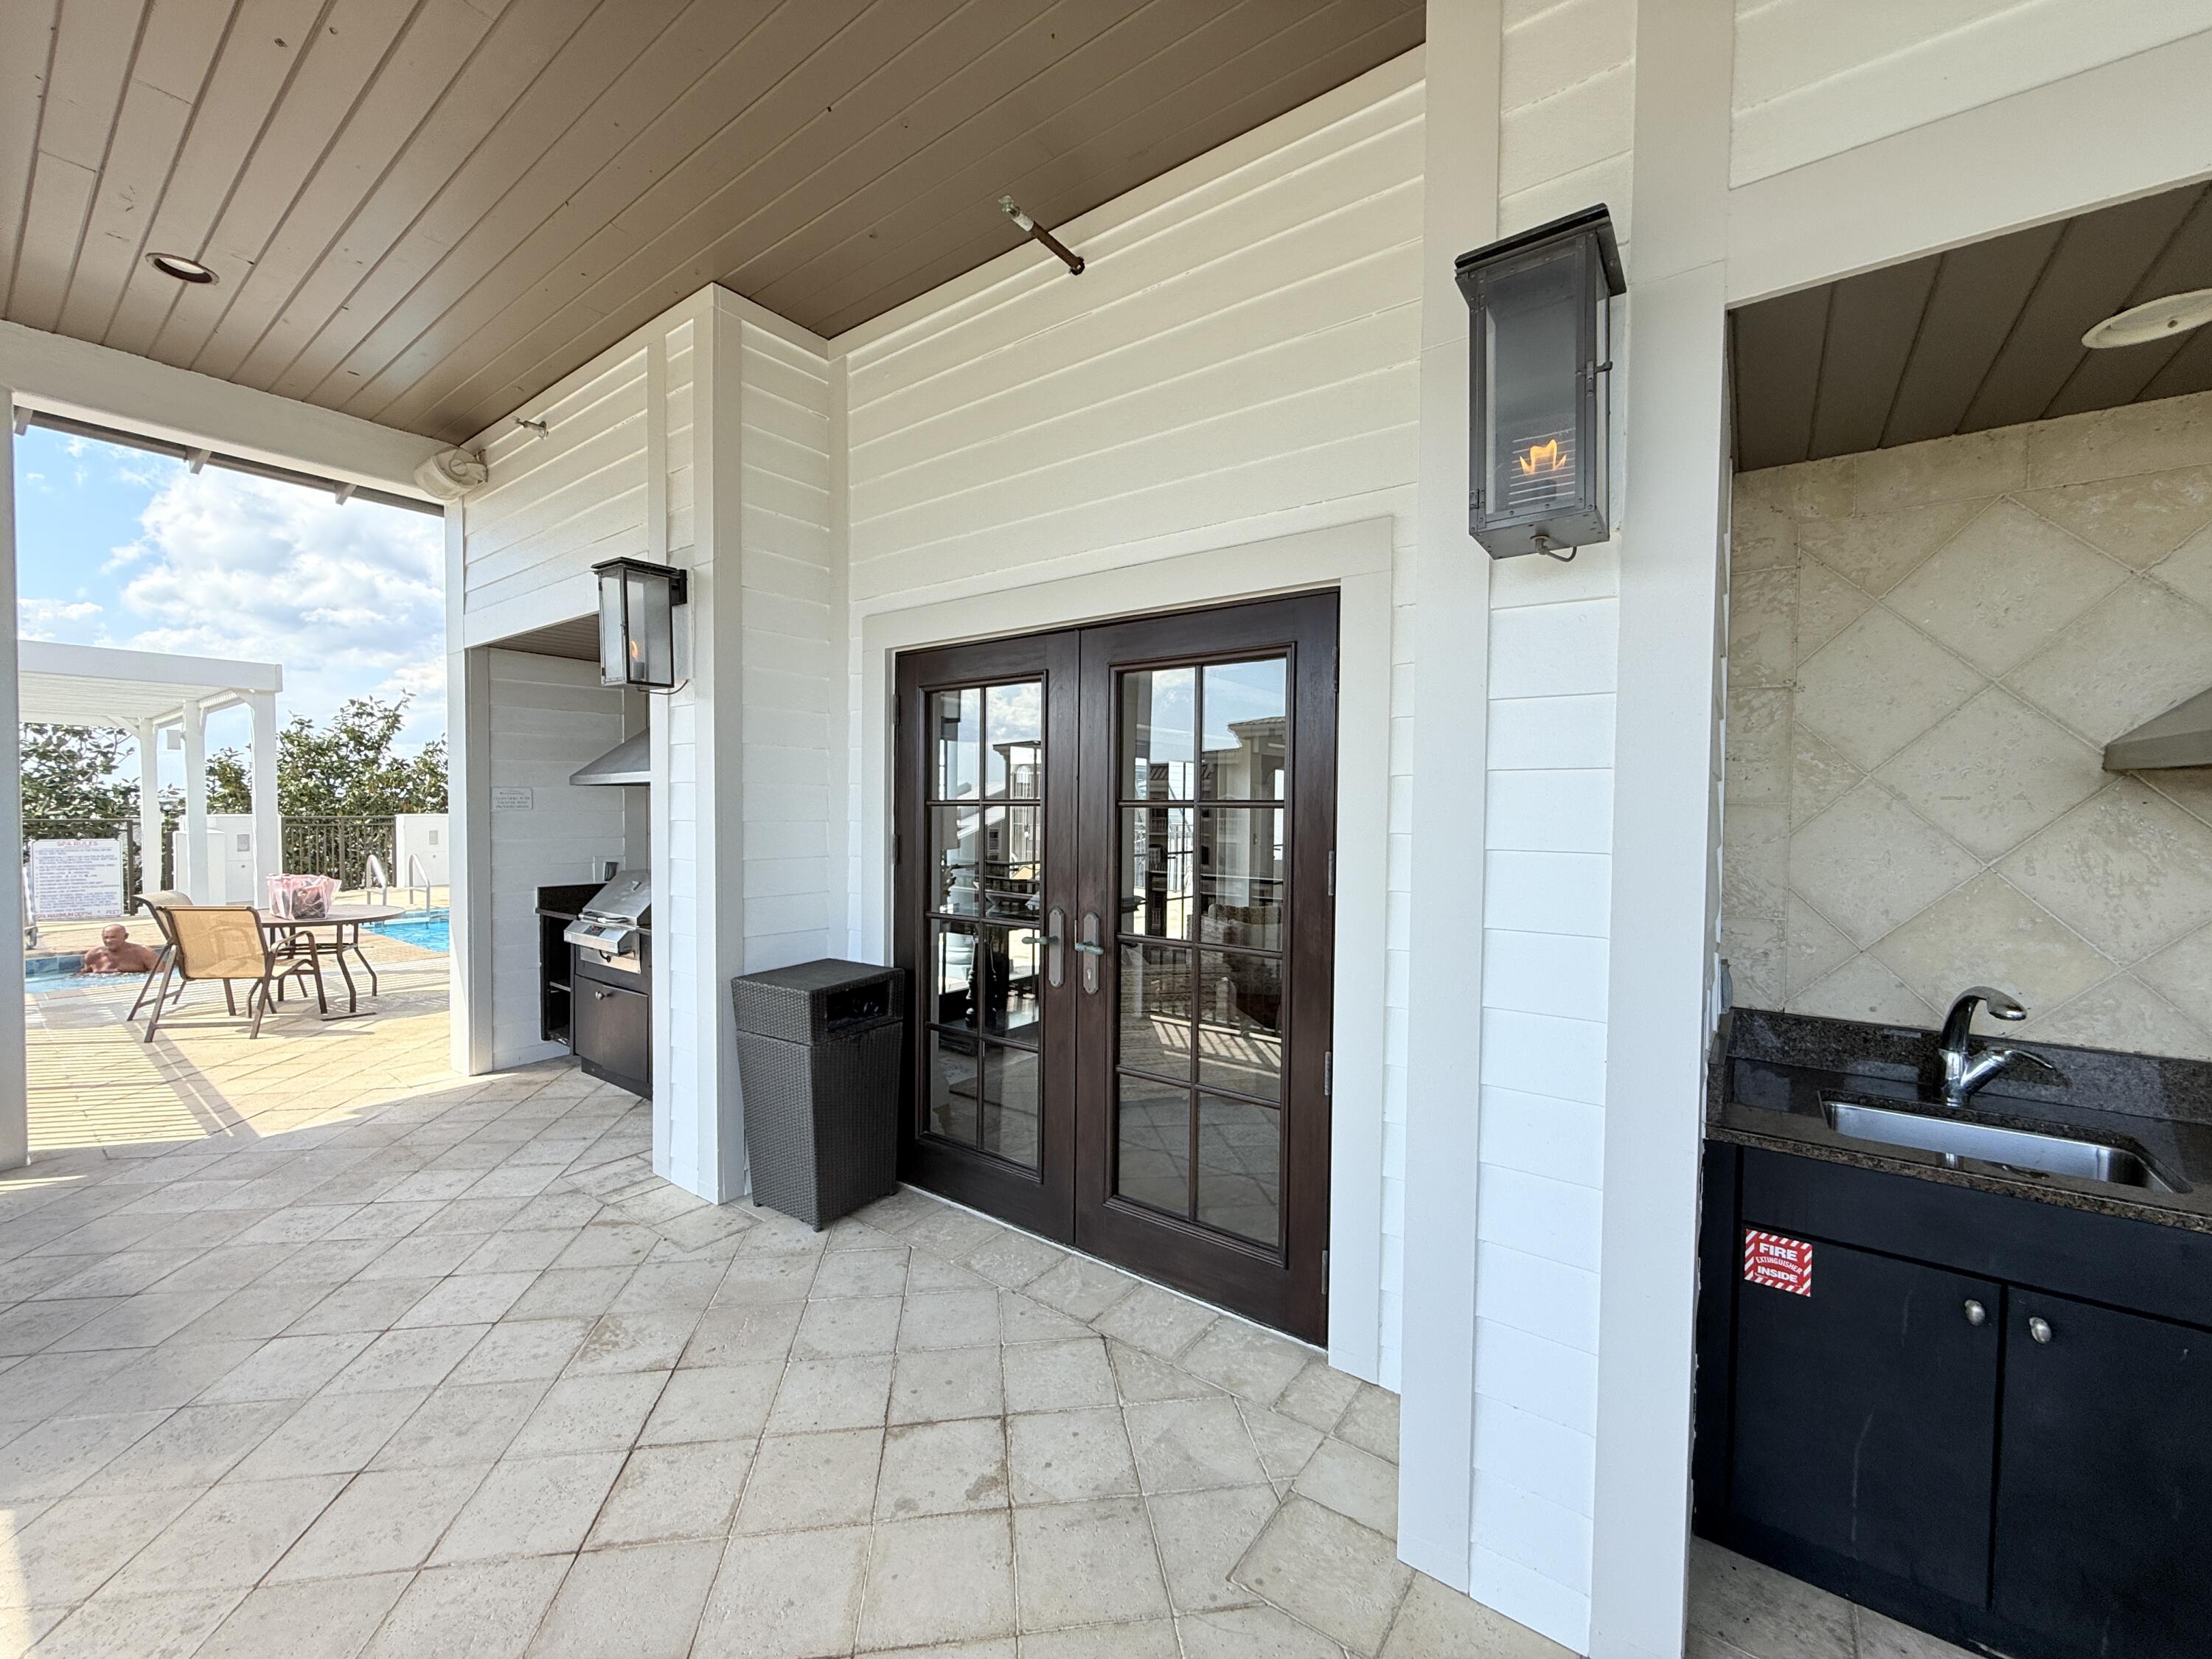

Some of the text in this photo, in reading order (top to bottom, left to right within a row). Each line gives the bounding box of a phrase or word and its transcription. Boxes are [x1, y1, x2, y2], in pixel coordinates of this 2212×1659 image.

[1759, 1242, 1798, 1261] FIRE
[1756, 1256, 1803, 1274] EXTINGUISHER
[1757, 1266, 1798, 1283] INSIDE
